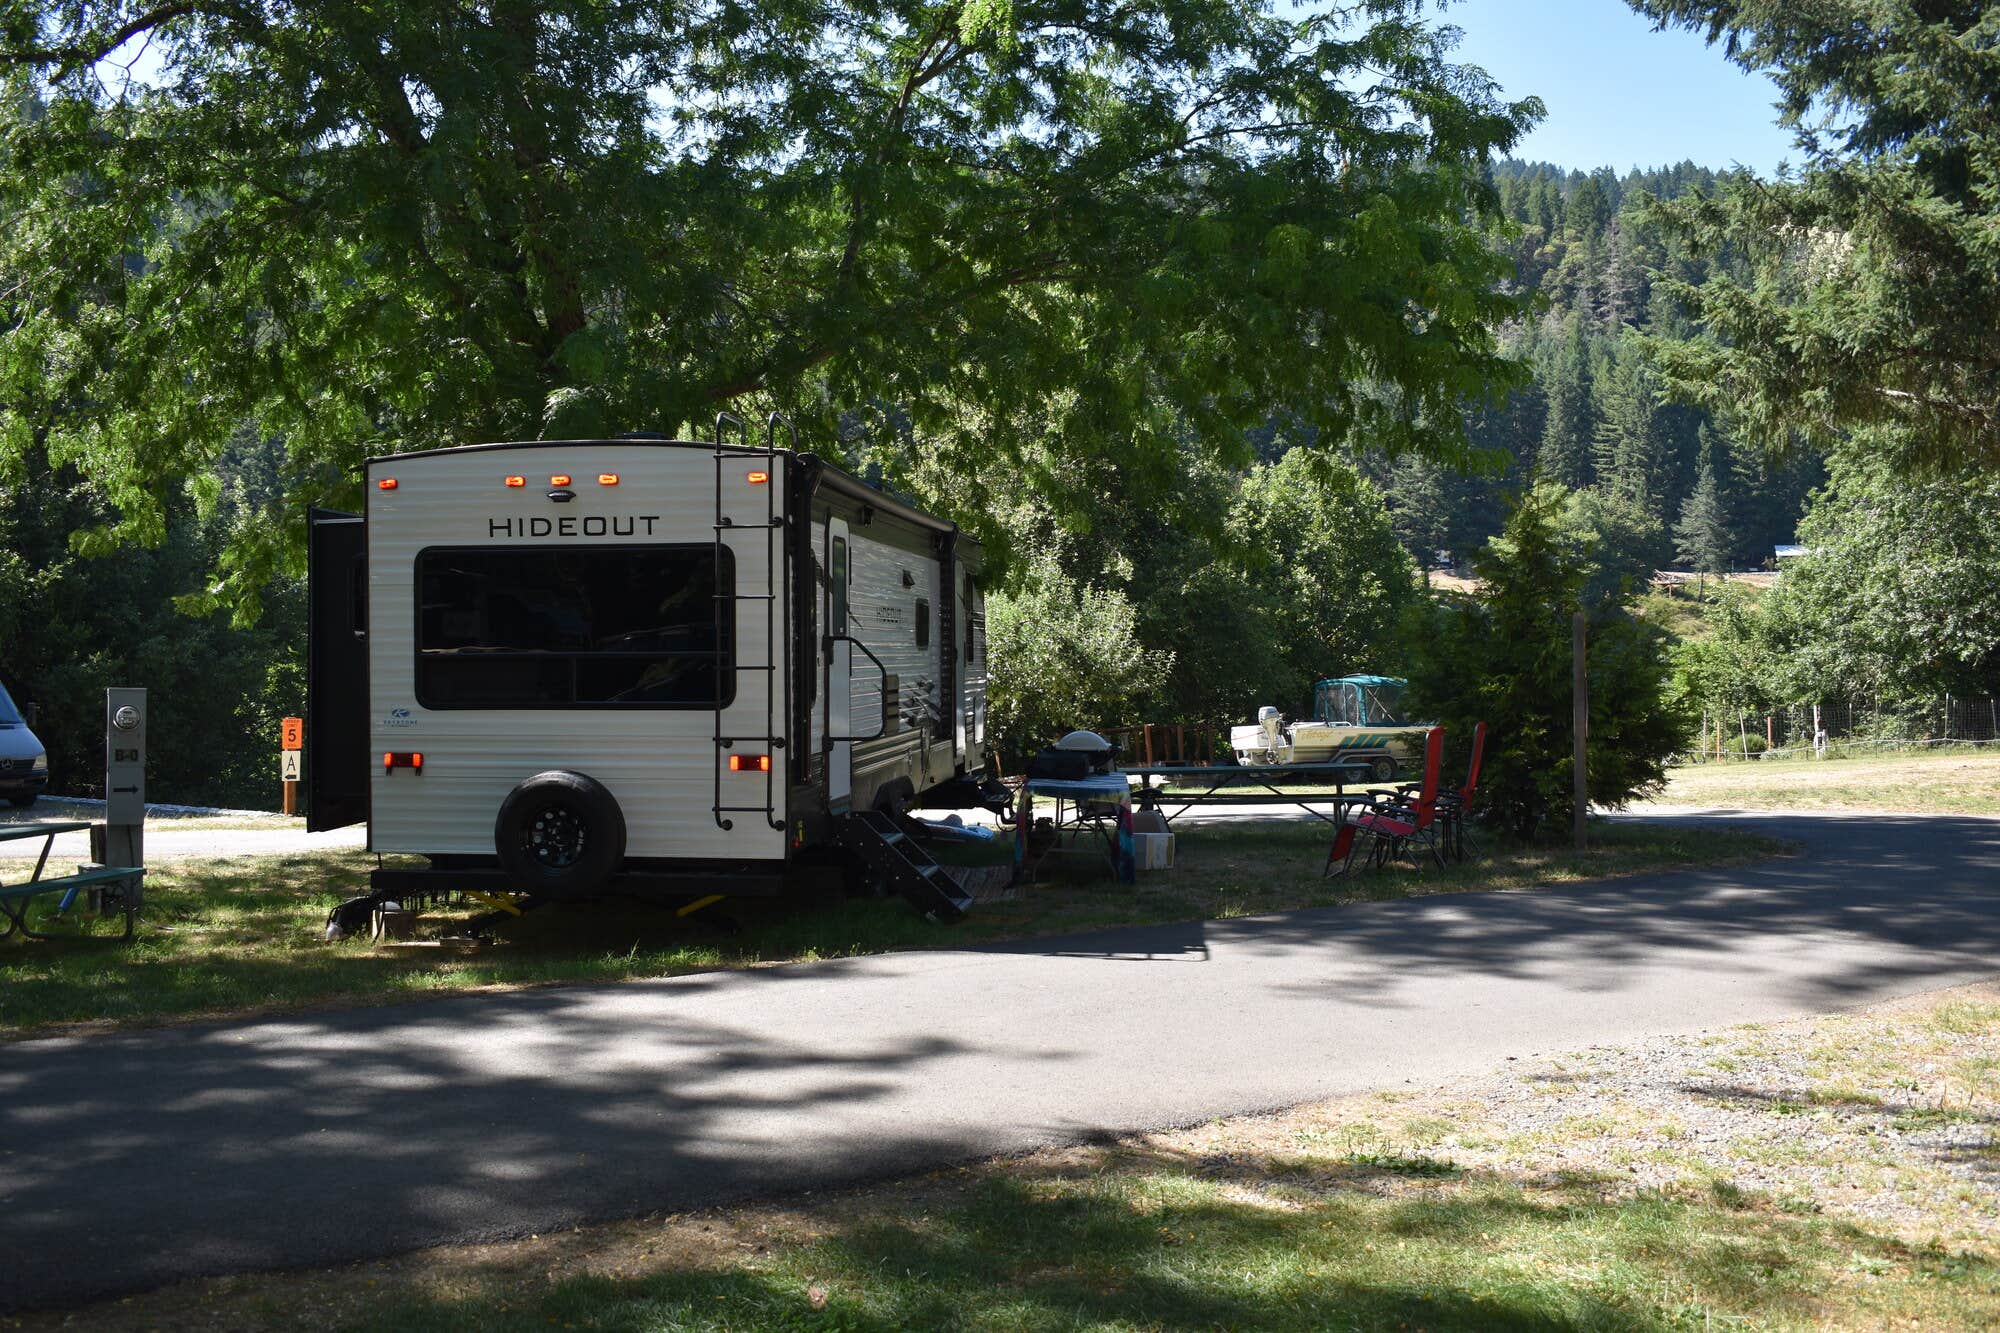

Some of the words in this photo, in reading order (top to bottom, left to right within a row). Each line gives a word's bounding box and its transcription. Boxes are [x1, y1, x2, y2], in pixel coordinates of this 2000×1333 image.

[489, 516, 660, 538] HIDEOUT
[288, 729, 296, 742] 5
[286, 754, 296, 771] A
